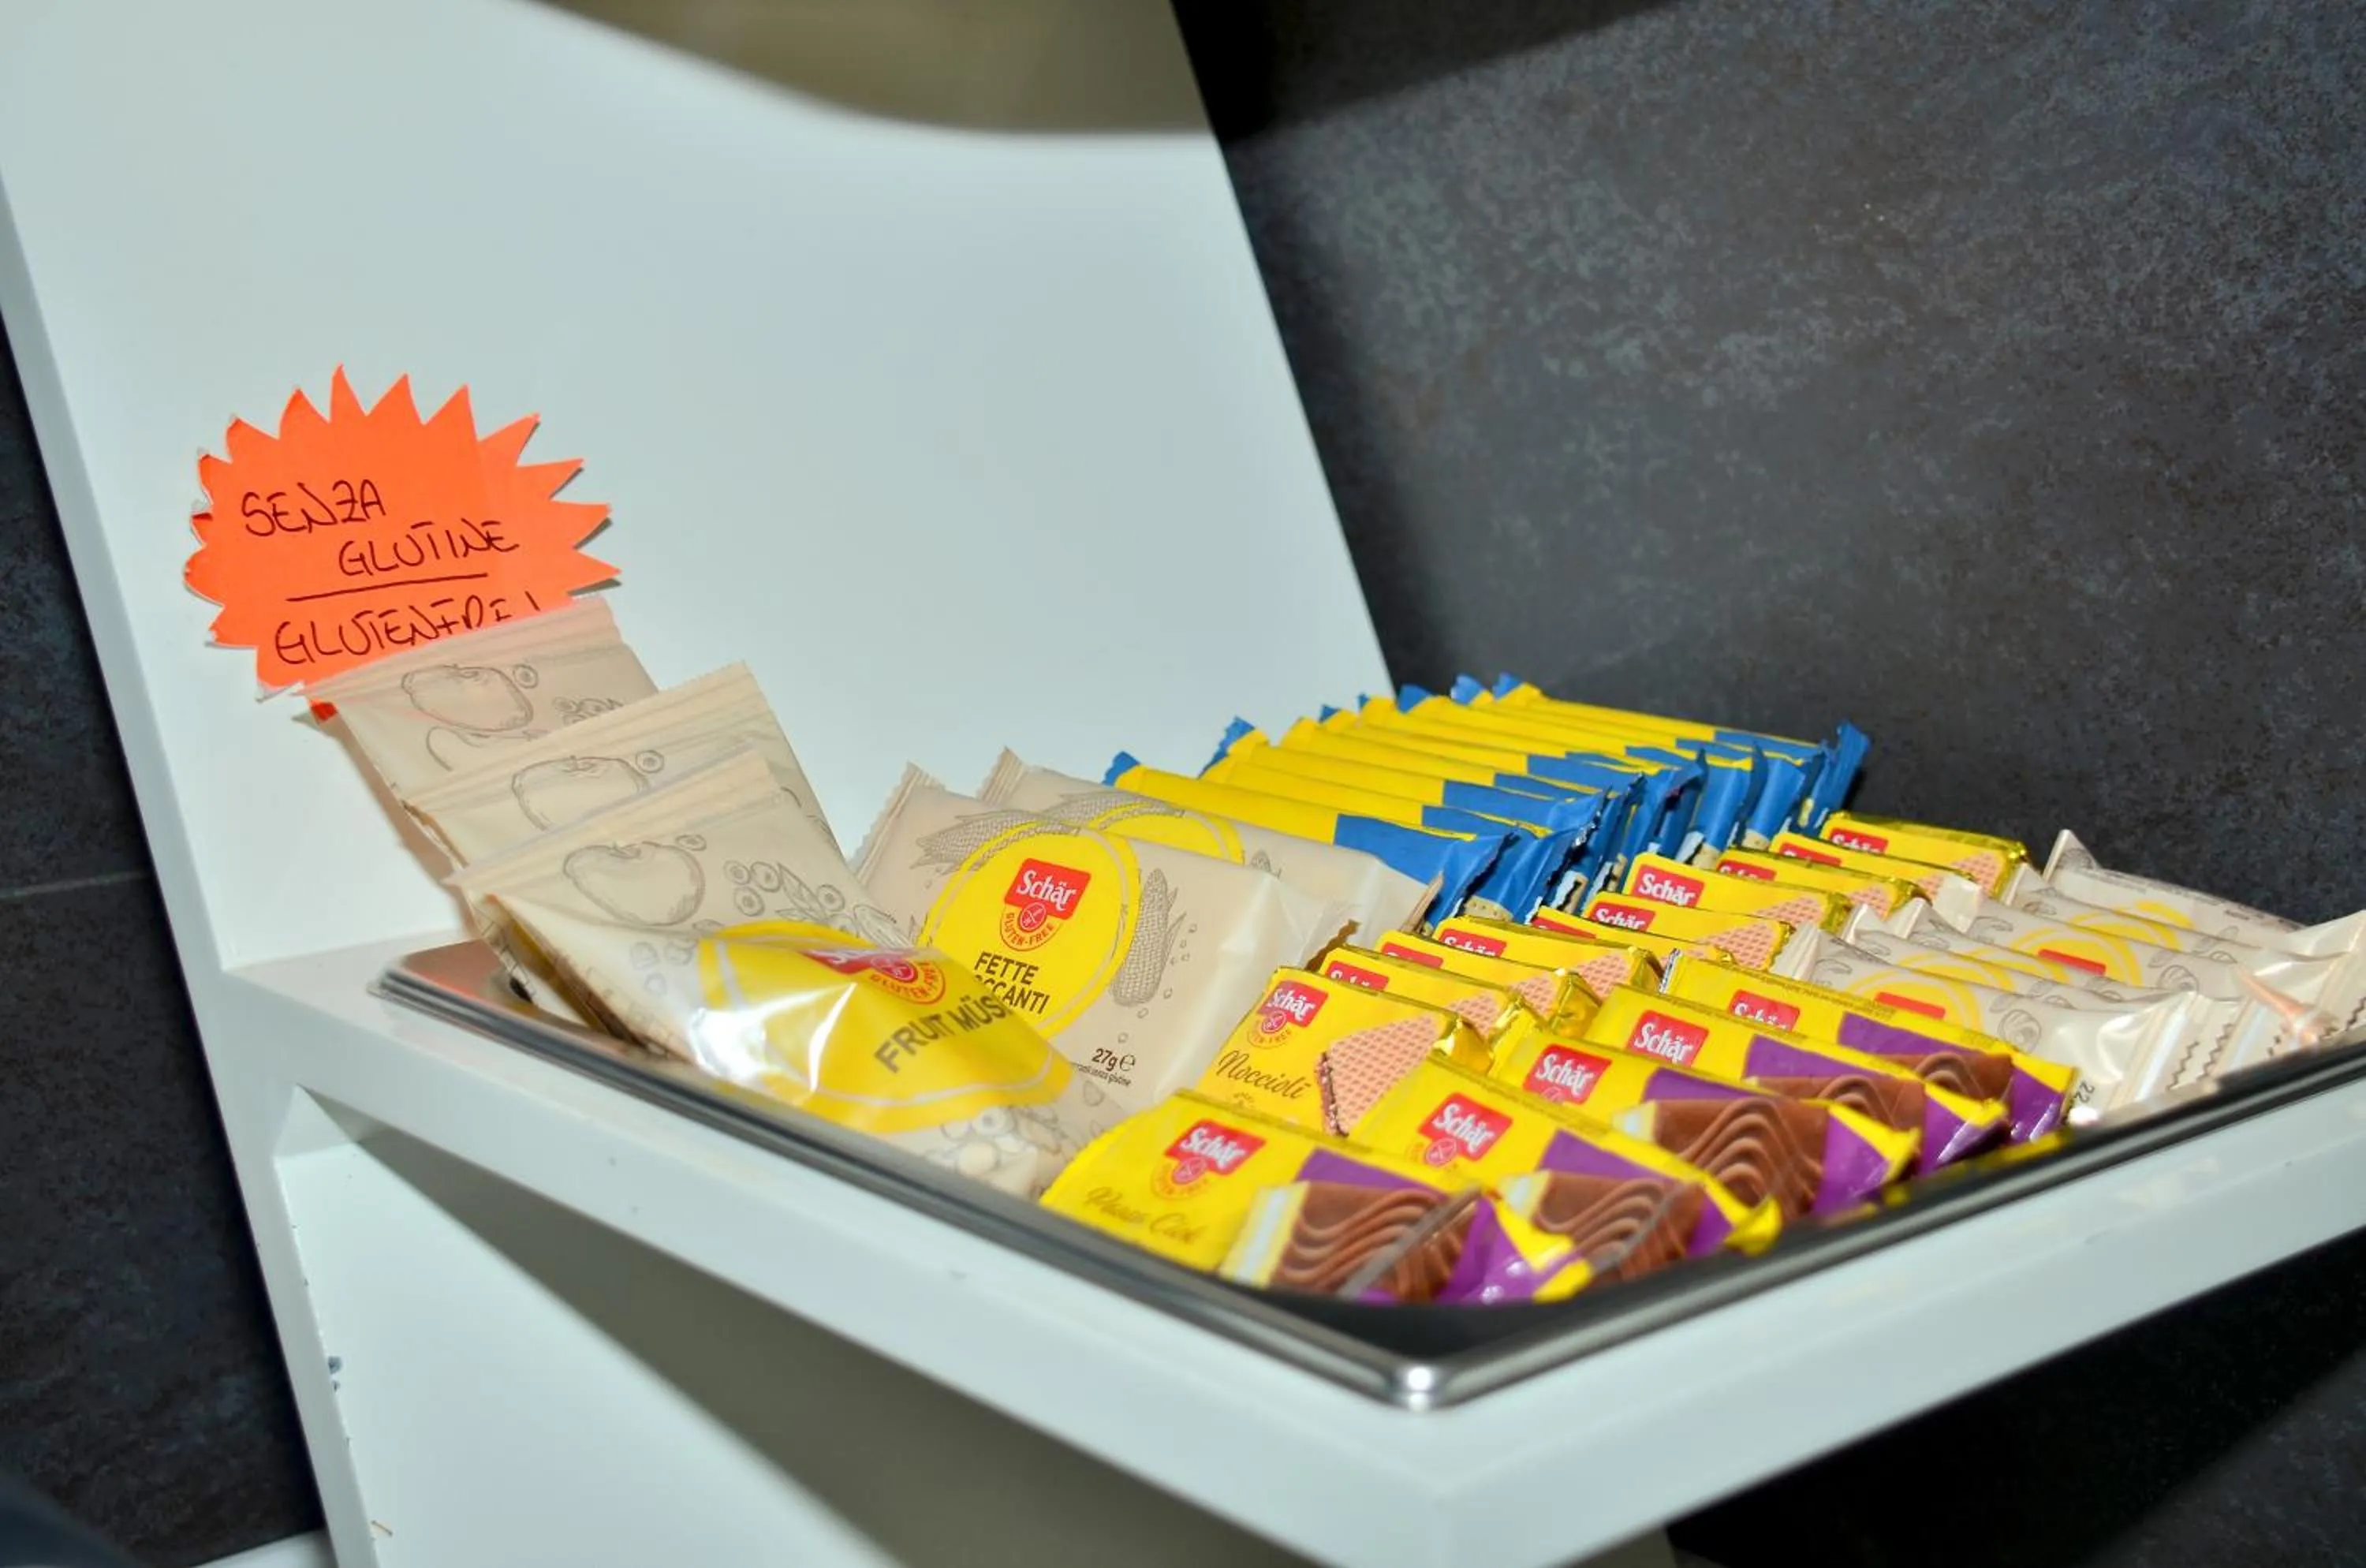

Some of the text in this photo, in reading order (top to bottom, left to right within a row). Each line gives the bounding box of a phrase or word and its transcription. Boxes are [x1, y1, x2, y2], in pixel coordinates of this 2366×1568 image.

[241, 480, 386, 536] SENZA
[338, 518, 520, 577] GLUTINE
[1016, 869, 1077, 911] Schär
[1639, 873, 1696, 906] Schär
[1004, 912, 1055, 946] GLUTEN-FREE
[974, 950, 1039, 985] FETTE
[874, 1014, 956, 1073] FRUIT
[1634, 1022, 1693, 1062] Schär
[1216, 1050, 1312, 1099] Noccioli
[1535, 1053, 1595, 1097] Schär
[1180, 1127, 1246, 1170] Schär
[1431, 1103, 1495, 1155] Schär
